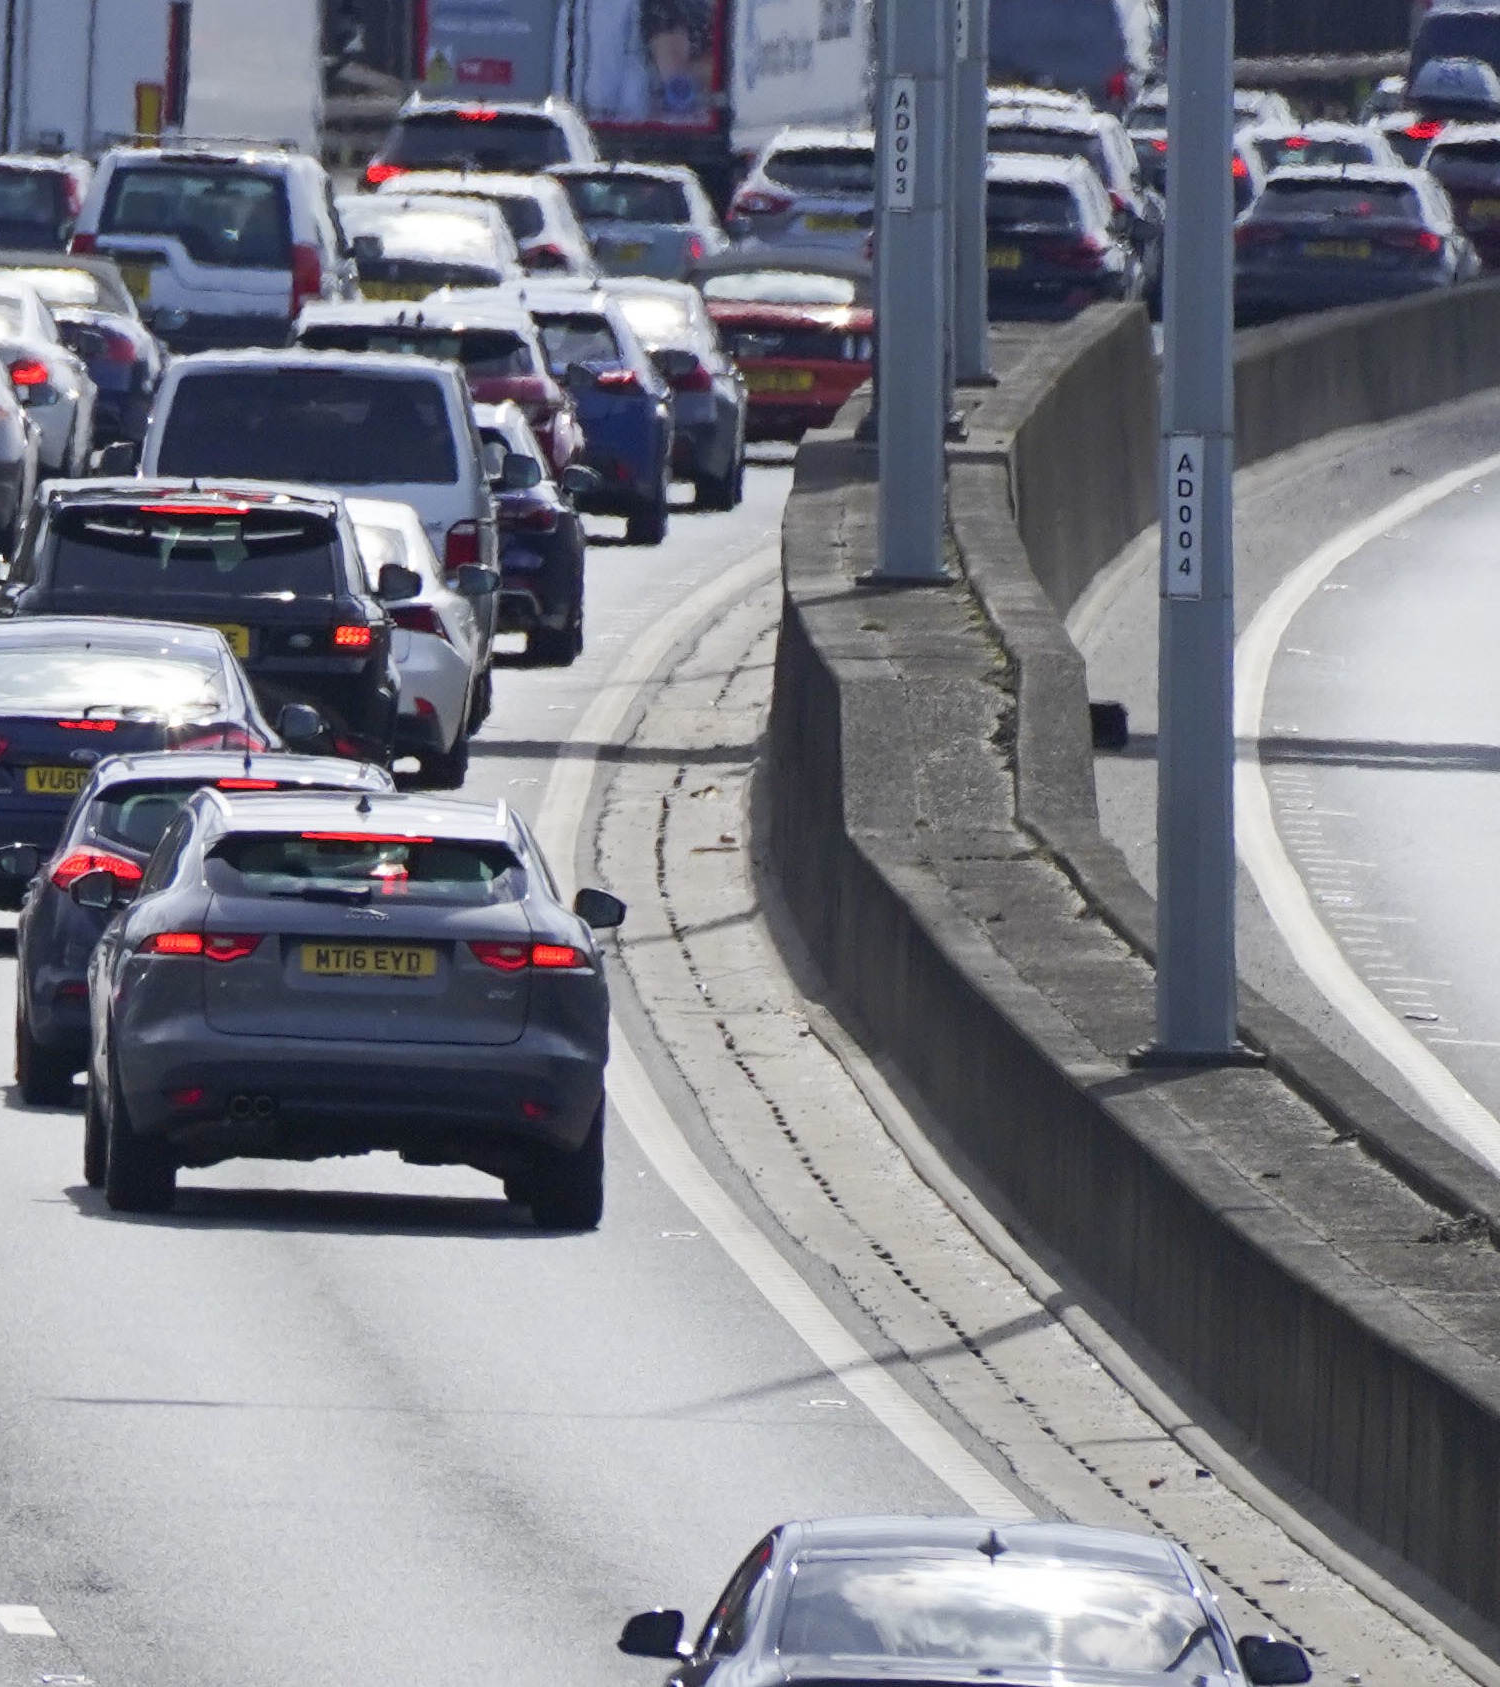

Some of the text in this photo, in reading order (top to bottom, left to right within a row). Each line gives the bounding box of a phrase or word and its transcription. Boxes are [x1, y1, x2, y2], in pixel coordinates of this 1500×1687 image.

[895, 91, 910, 194] AD003
[1177, 454, 1193, 576] AD004
[317, 950, 421, 972] MT16 EYD
